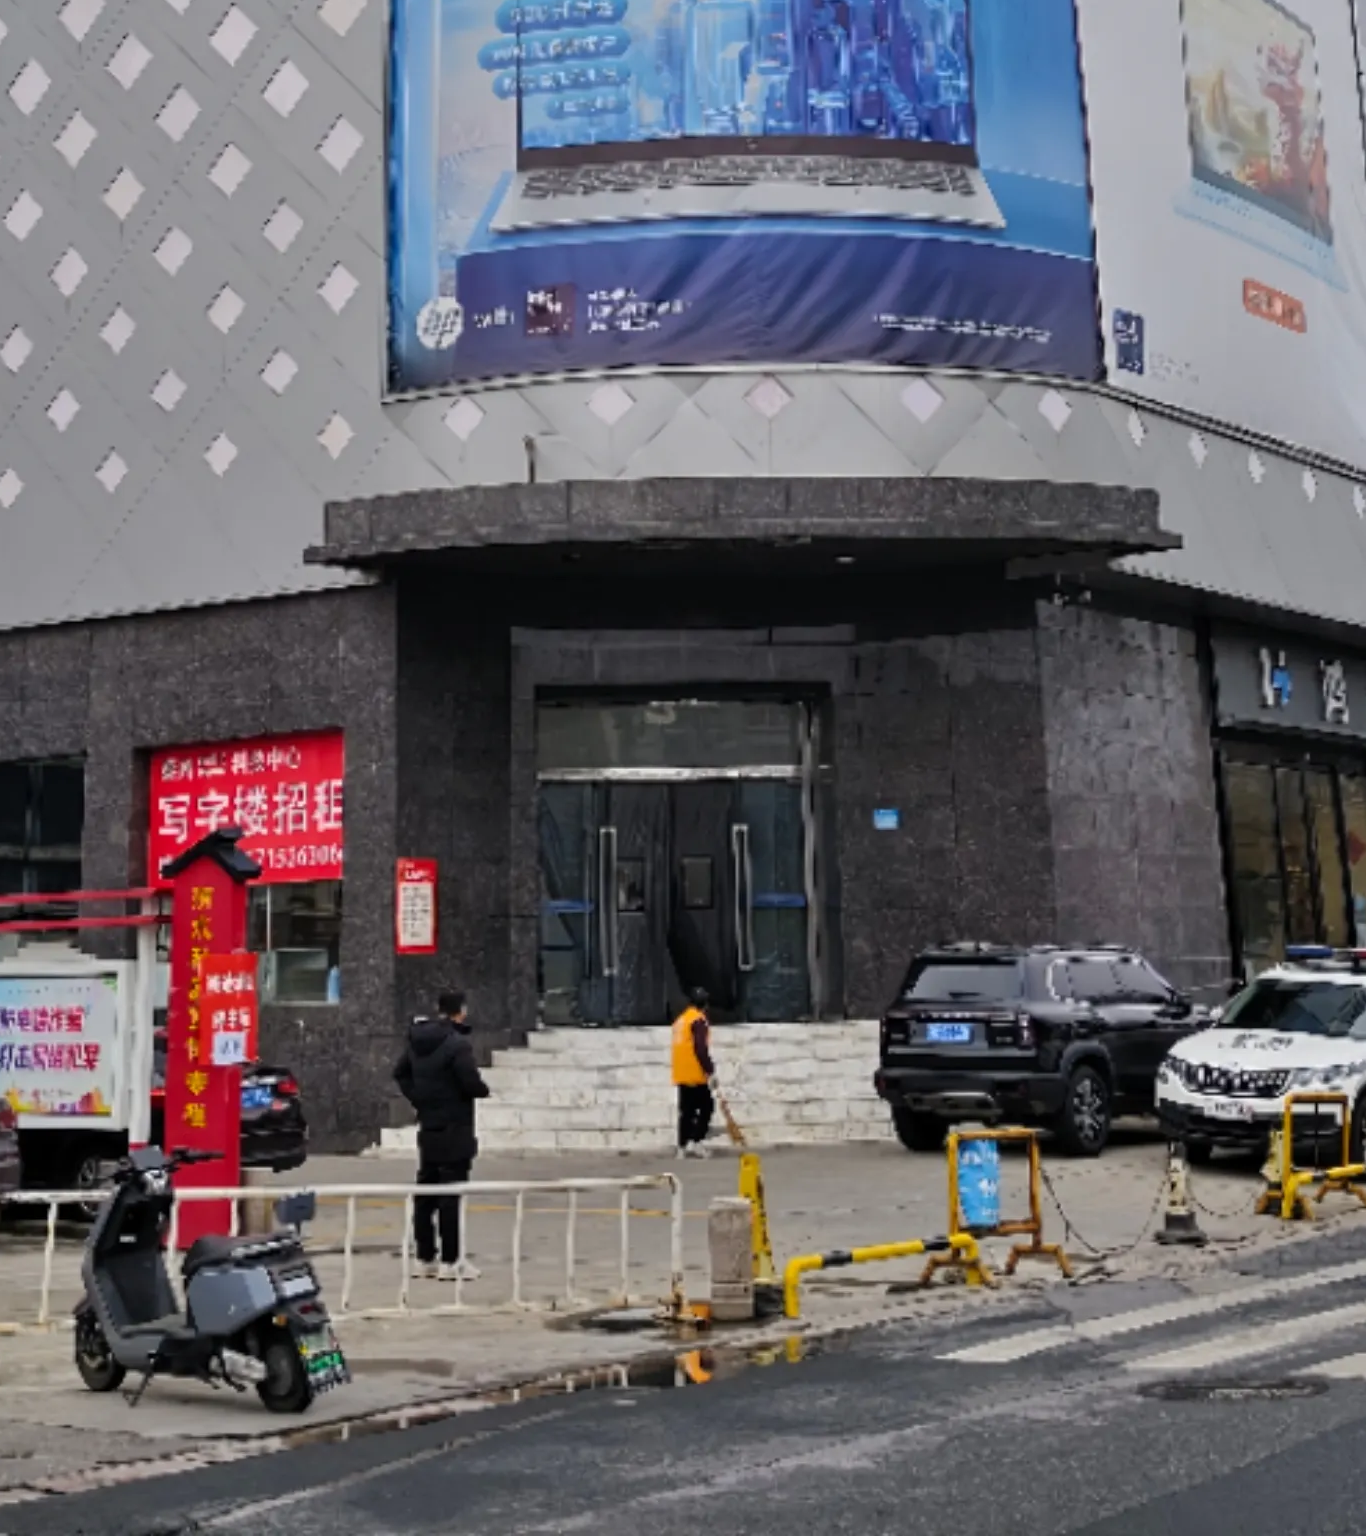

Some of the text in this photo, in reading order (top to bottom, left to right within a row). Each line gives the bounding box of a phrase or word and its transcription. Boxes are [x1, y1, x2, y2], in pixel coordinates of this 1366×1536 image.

[158, 778, 343, 843] 写字楼招租
